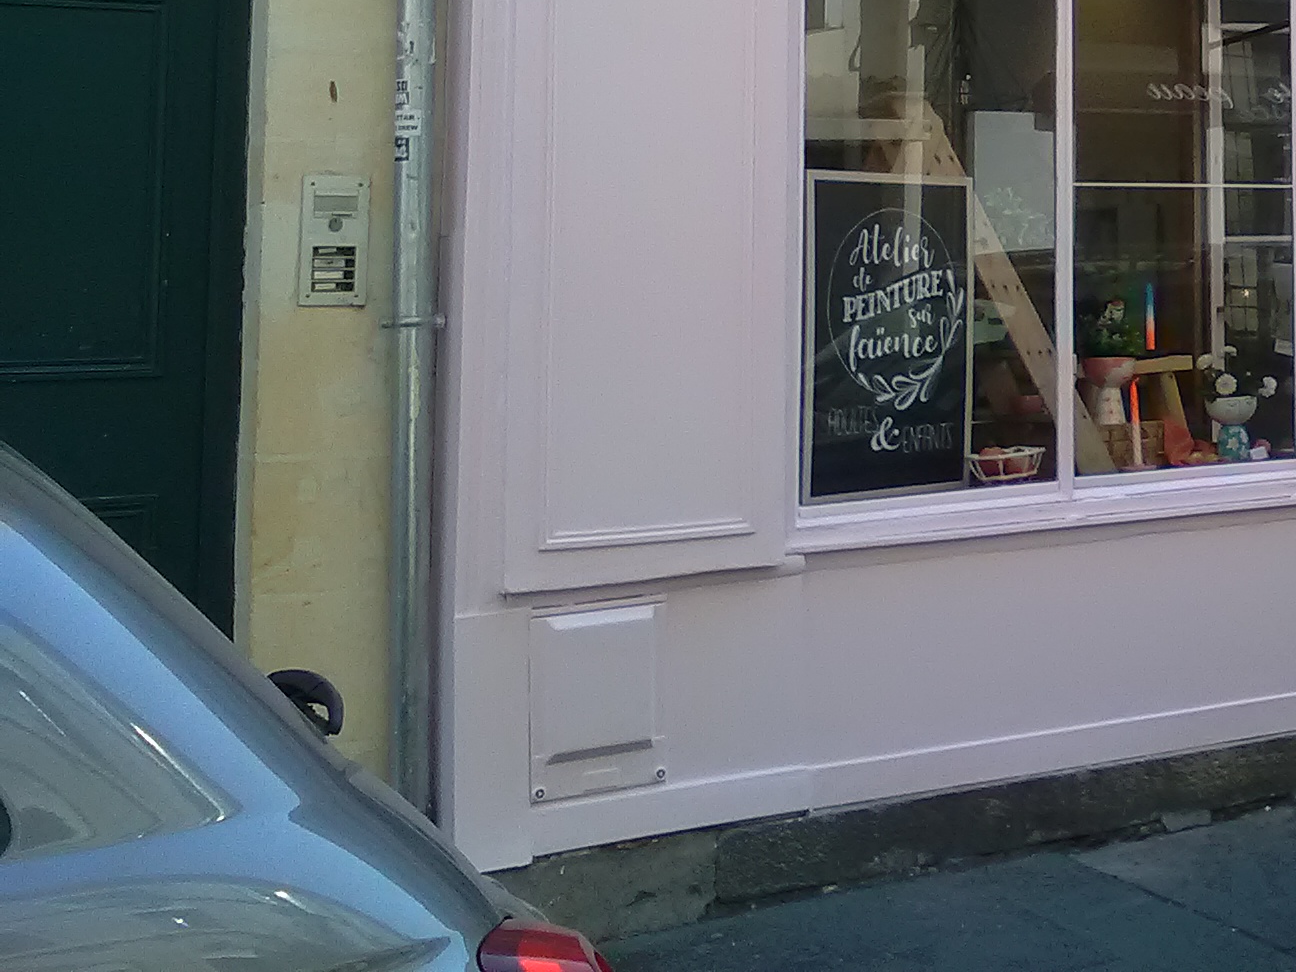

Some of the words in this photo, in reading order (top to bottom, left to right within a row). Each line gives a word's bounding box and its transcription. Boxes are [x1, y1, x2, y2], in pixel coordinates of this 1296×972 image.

[849, 223, 936, 269] Atelier
[842, 269, 944, 324] PEINTURE
[852, 266, 873, 293] de
[907, 303, 935, 329] sur
[848, 324, 939, 373] faïence
[870, 416, 901, 452] &
